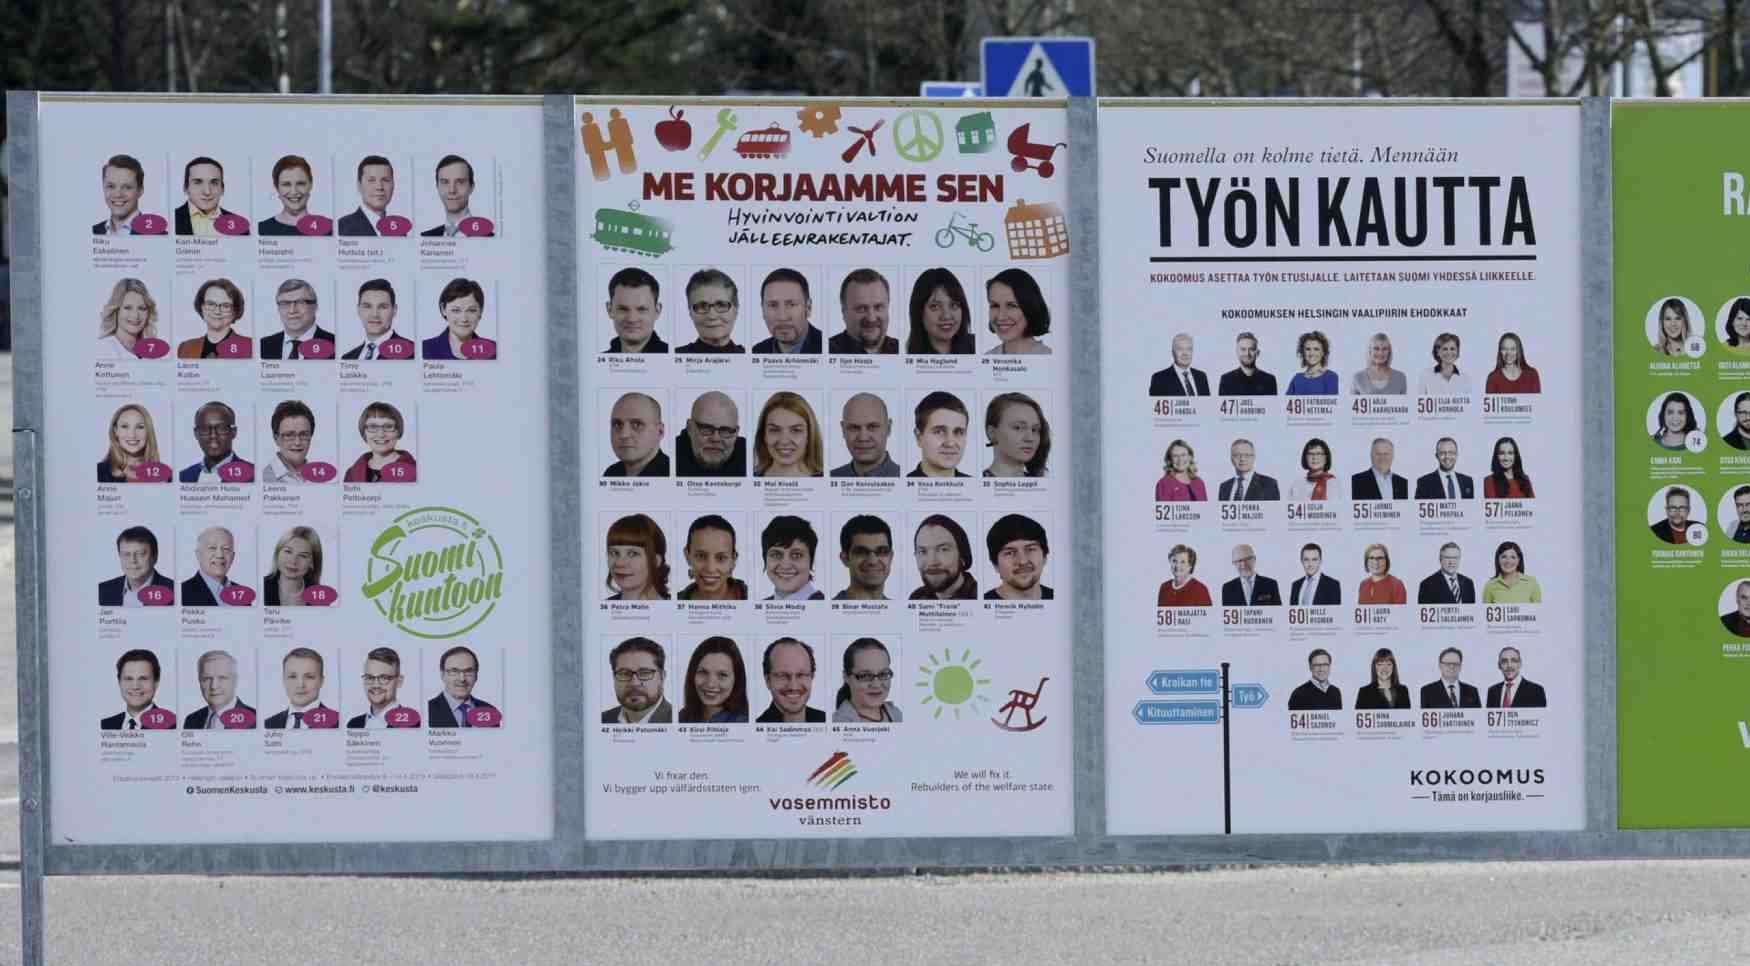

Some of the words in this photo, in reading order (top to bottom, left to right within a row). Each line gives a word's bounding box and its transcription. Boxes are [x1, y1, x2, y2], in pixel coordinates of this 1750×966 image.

[1144, 146, 1226, 165] Suomella
[1233, 151, 1254, 163] on
[1262, 147, 1313, 163] kolme
[1320, 148, 1363, 164] tietä.
[1370, 147, 1458, 164] Mennään
[642, 172, 694, 200] ME
[705, 172, 926, 201] KORJAAMME
[937, 174, 1004, 202] SEN
[1149, 176, 1300, 247] TYÖN
[1318, 176, 1536, 247] KAUTTA
[728, 227, 911, 247] JÄLLEENRAKENTAJAT.
[1150, 272, 1205, 283] KOKOOMUS
[1208, 272, 1249, 283] ASETTAA
[1251, 270, 1278, 282] TYÖN
[1344, 272, 1396, 282] LAITETAAN
[1399, 272, 1429, 282] SUOMI
[1433, 270, 1477, 282] YHDESSÄ
[1222, 309, 1295, 320] KOKOOMUKSEN
[1298, 309, 1349, 319] HELSINGIN
[1351, 308, 1408, 319] VAALIPIIRIN
[1410, 308, 1466, 318] EHDOKKAAT
[388, 344, 401, 353] 10
[472, 345, 483, 353] 11
[1154, 400, 1169, 414] 46
[1221, 400, 1235, 414] 47
[1286, 399, 1301, 414] 48
[1352, 398, 1367, 414] 49
[1418, 398, 1433, 413] 50
[1484, 398, 1496, 412] 51
[146, 468, 160, 476] 12
[228, 468, 241, 476] 13
[312, 468, 325, 476] 14
[390, 468, 403, 476] 15
[1155, 505, 1170, 520] 52
[1222, 505, 1236, 519] 53
[1288, 504, 1302, 519] 54
[1354, 504, 1368, 518] 55
[1419, 503, 1434, 517] 56
[1485, 503, 1499, 517] 57
[362, 525, 486, 598] Suomi
[148, 591, 161, 599] 16
[231, 591, 244, 599] 17
[312, 591, 325, 599] 18
[388, 572, 502, 623] kantoon
[1157, 610, 1172, 625] 58
[1224, 610, 1238, 624] 59
[1289, 609, 1304, 624] 60
[1355, 608, 1367, 623] 61
[1421, 608, 1435, 622] 62
[1486, 607, 1501, 621] 63
[151, 714, 163, 722] 19
[231, 714, 244, 722] 20
[314, 713, 326, 722] 21
[395, 713, 408, 721] 22
[477, 712, 490, 721] 23
[1291, 714, 1305, 728] 64
[1356, 713, 1371, 728] 65
[1422, 712, 1438, 727] 66
[1488, 712, 1502, 726] 67
[654, 771, 664, 780] Vi
[667, 771, 686, 780] fixar
[954, 770, 968, 778] We
[972, 770, 986, 778] will
[989, 770, 1000, 778] fix
[1411, 769, 1544, 785] KOKOOMUS
[196, 786, 268, 794] SuomenKeskusta
[603, 784, 612, 792] Vi
[615, 784, 646, 796] bygger
[650, 785, 667, 795] upp
[911, 783, 959, 792] Rebuilders
[962, 782, 971, 791] of
[975, 782, 990, 791] the
[993, 782, 1026, 791] welfare
[770, 796, 890, 810] vasemmisto
[1432, 791, 1455, 801] Tämä
[1458, 793, 1468, 801] on
[1471, 791, 1524, 803] korjausliike.
[799, 815, 861, 825] vänstern
